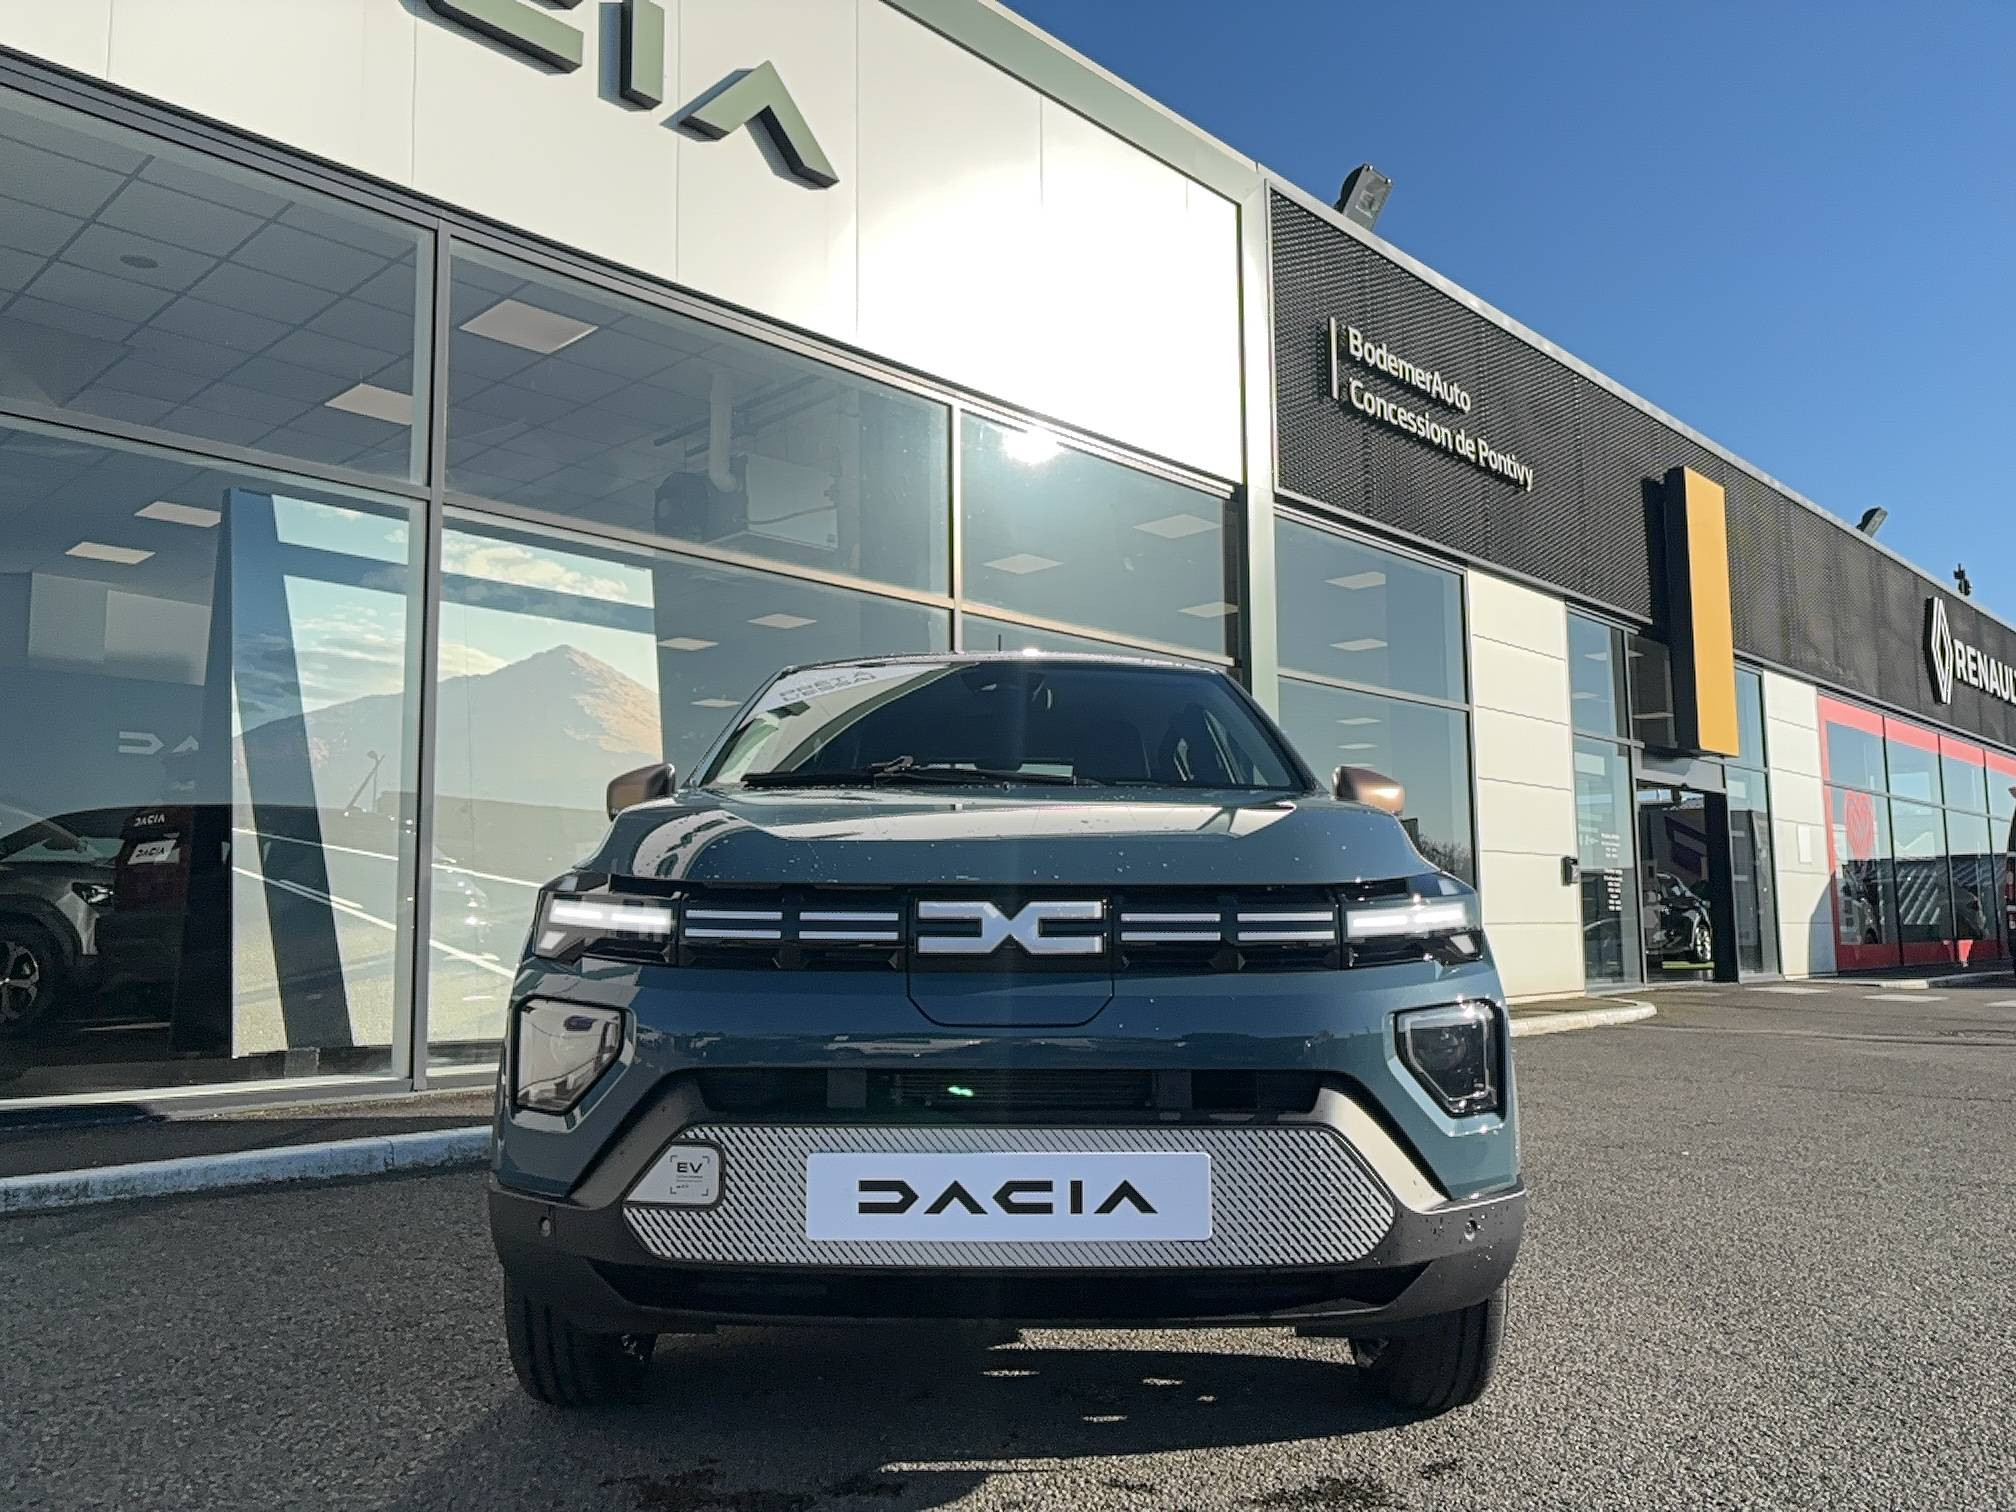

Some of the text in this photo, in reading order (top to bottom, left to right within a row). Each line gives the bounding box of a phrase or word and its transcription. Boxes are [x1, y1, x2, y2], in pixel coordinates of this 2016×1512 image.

[1348, 325, 1471, 413] BodemerAuto
[1350, 378, 1534, 492] Concession de Pontivy
[1953, 638, 2016, 705] RENAUL
[677, 1161, 703, 1174] EV
[858, 1179, 1159, 1215] DACIA
